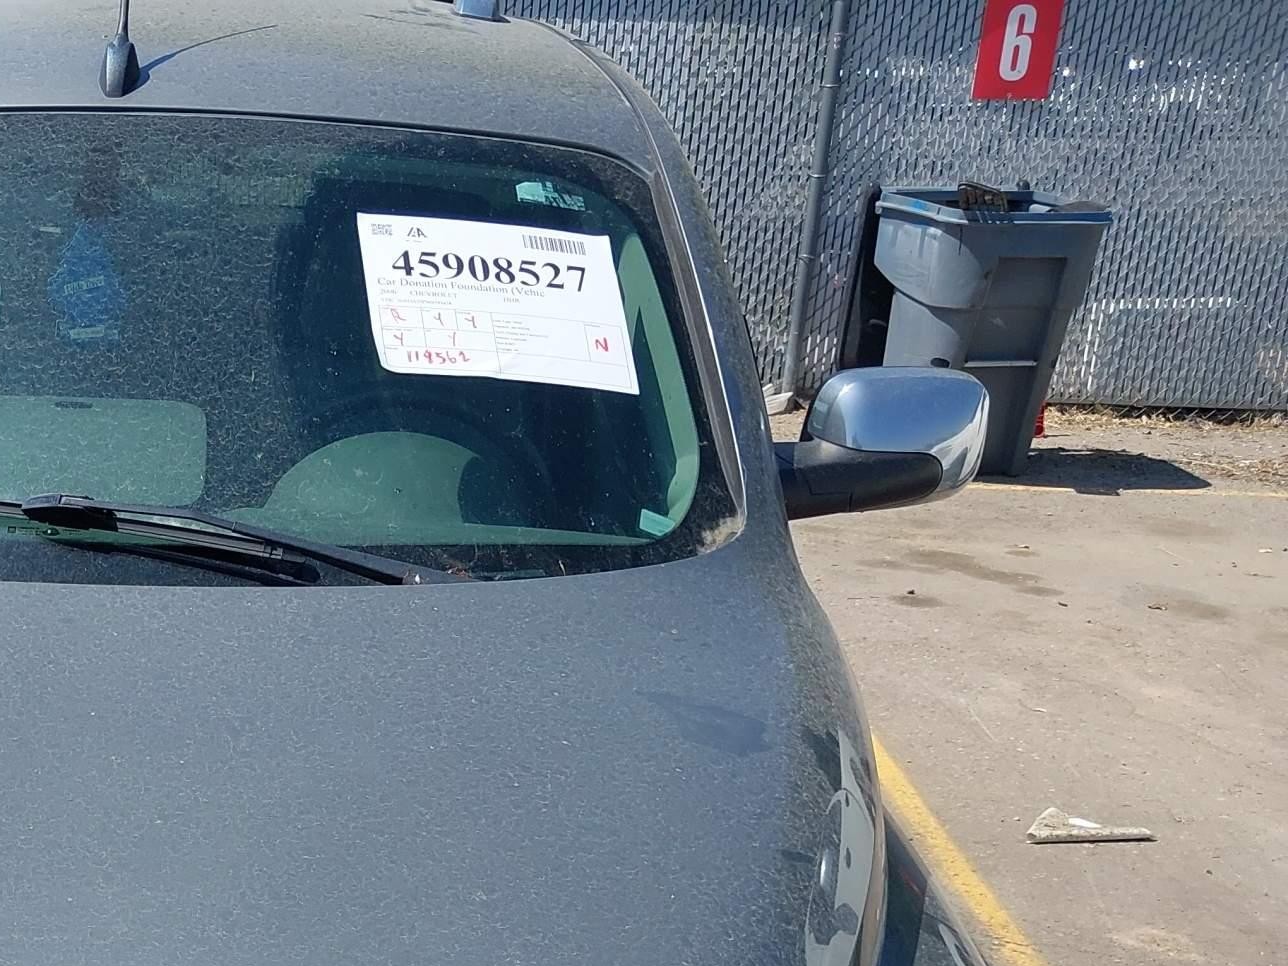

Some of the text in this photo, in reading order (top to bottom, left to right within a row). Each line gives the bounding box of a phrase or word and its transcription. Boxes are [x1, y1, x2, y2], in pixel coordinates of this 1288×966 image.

[999, 3, 1037, 81] 6
[391, 249, 586, 292] 45908527
[376, 277, 397, 286] Car
[399, 279, 449, 290] Donation
[450, 282, 509, 295] Foundation
[594, 337, 610, 352] N
